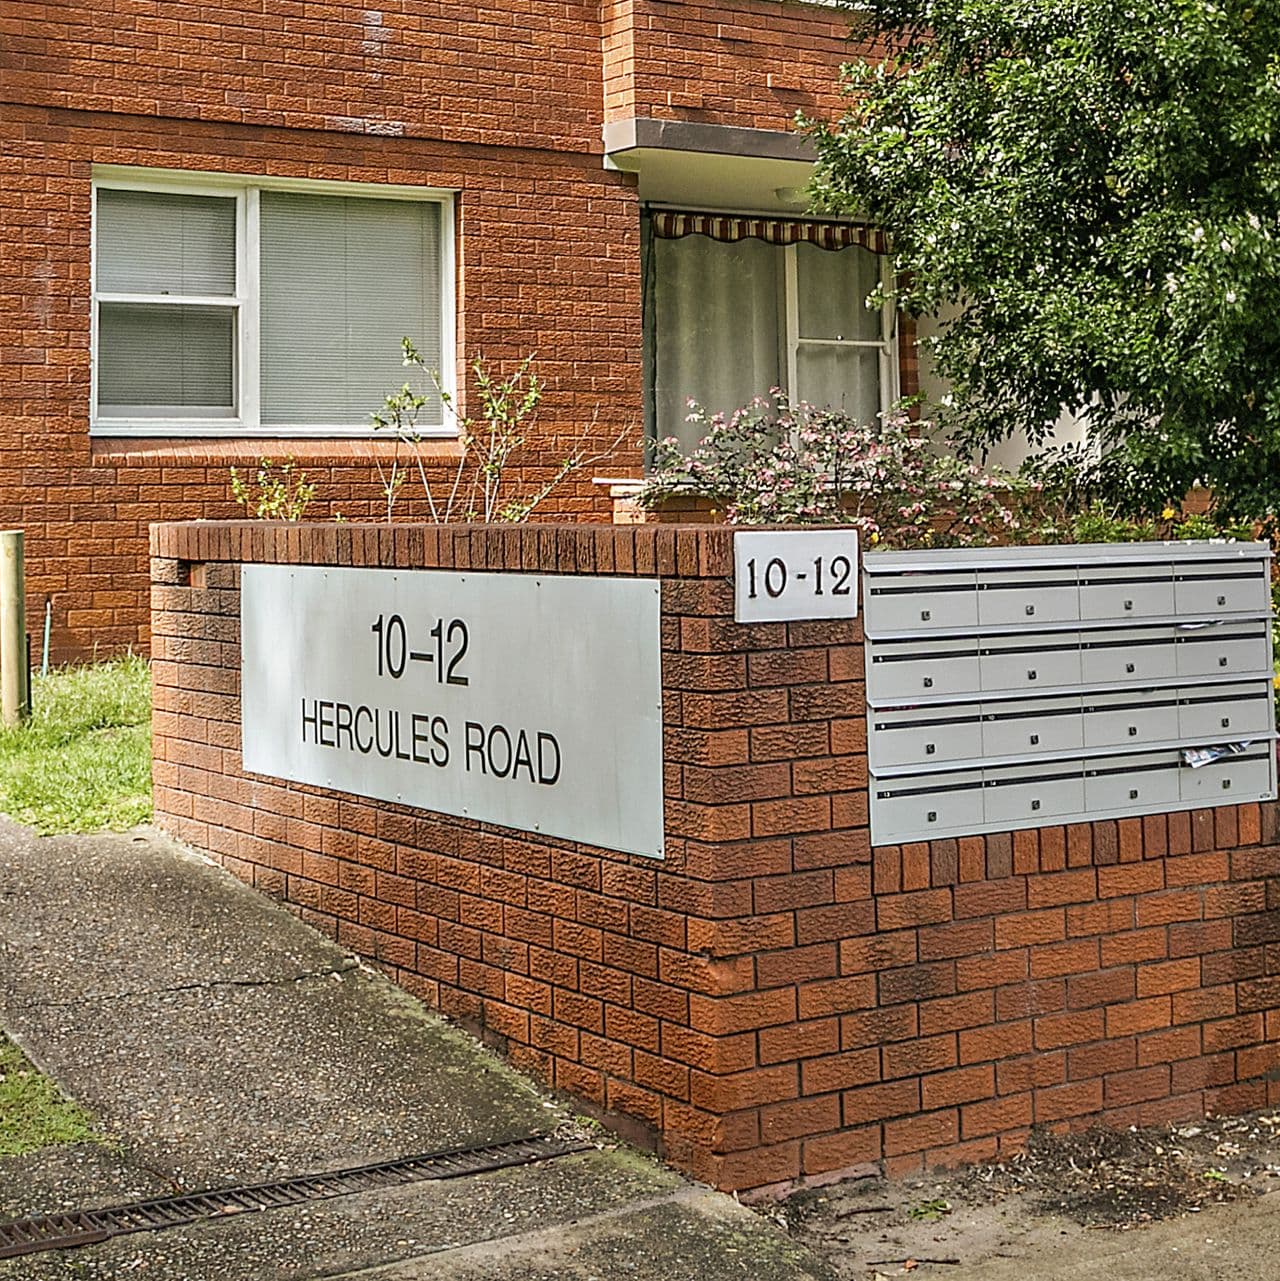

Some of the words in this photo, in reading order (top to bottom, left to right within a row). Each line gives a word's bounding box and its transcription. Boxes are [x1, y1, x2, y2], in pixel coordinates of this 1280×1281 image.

[747, 556, 851, 598] 10-12
[371, 614, 470, 687] 10-12
[301, 697, 450, 768] HERCULES
[465, 721, 561, 786] ROAD
